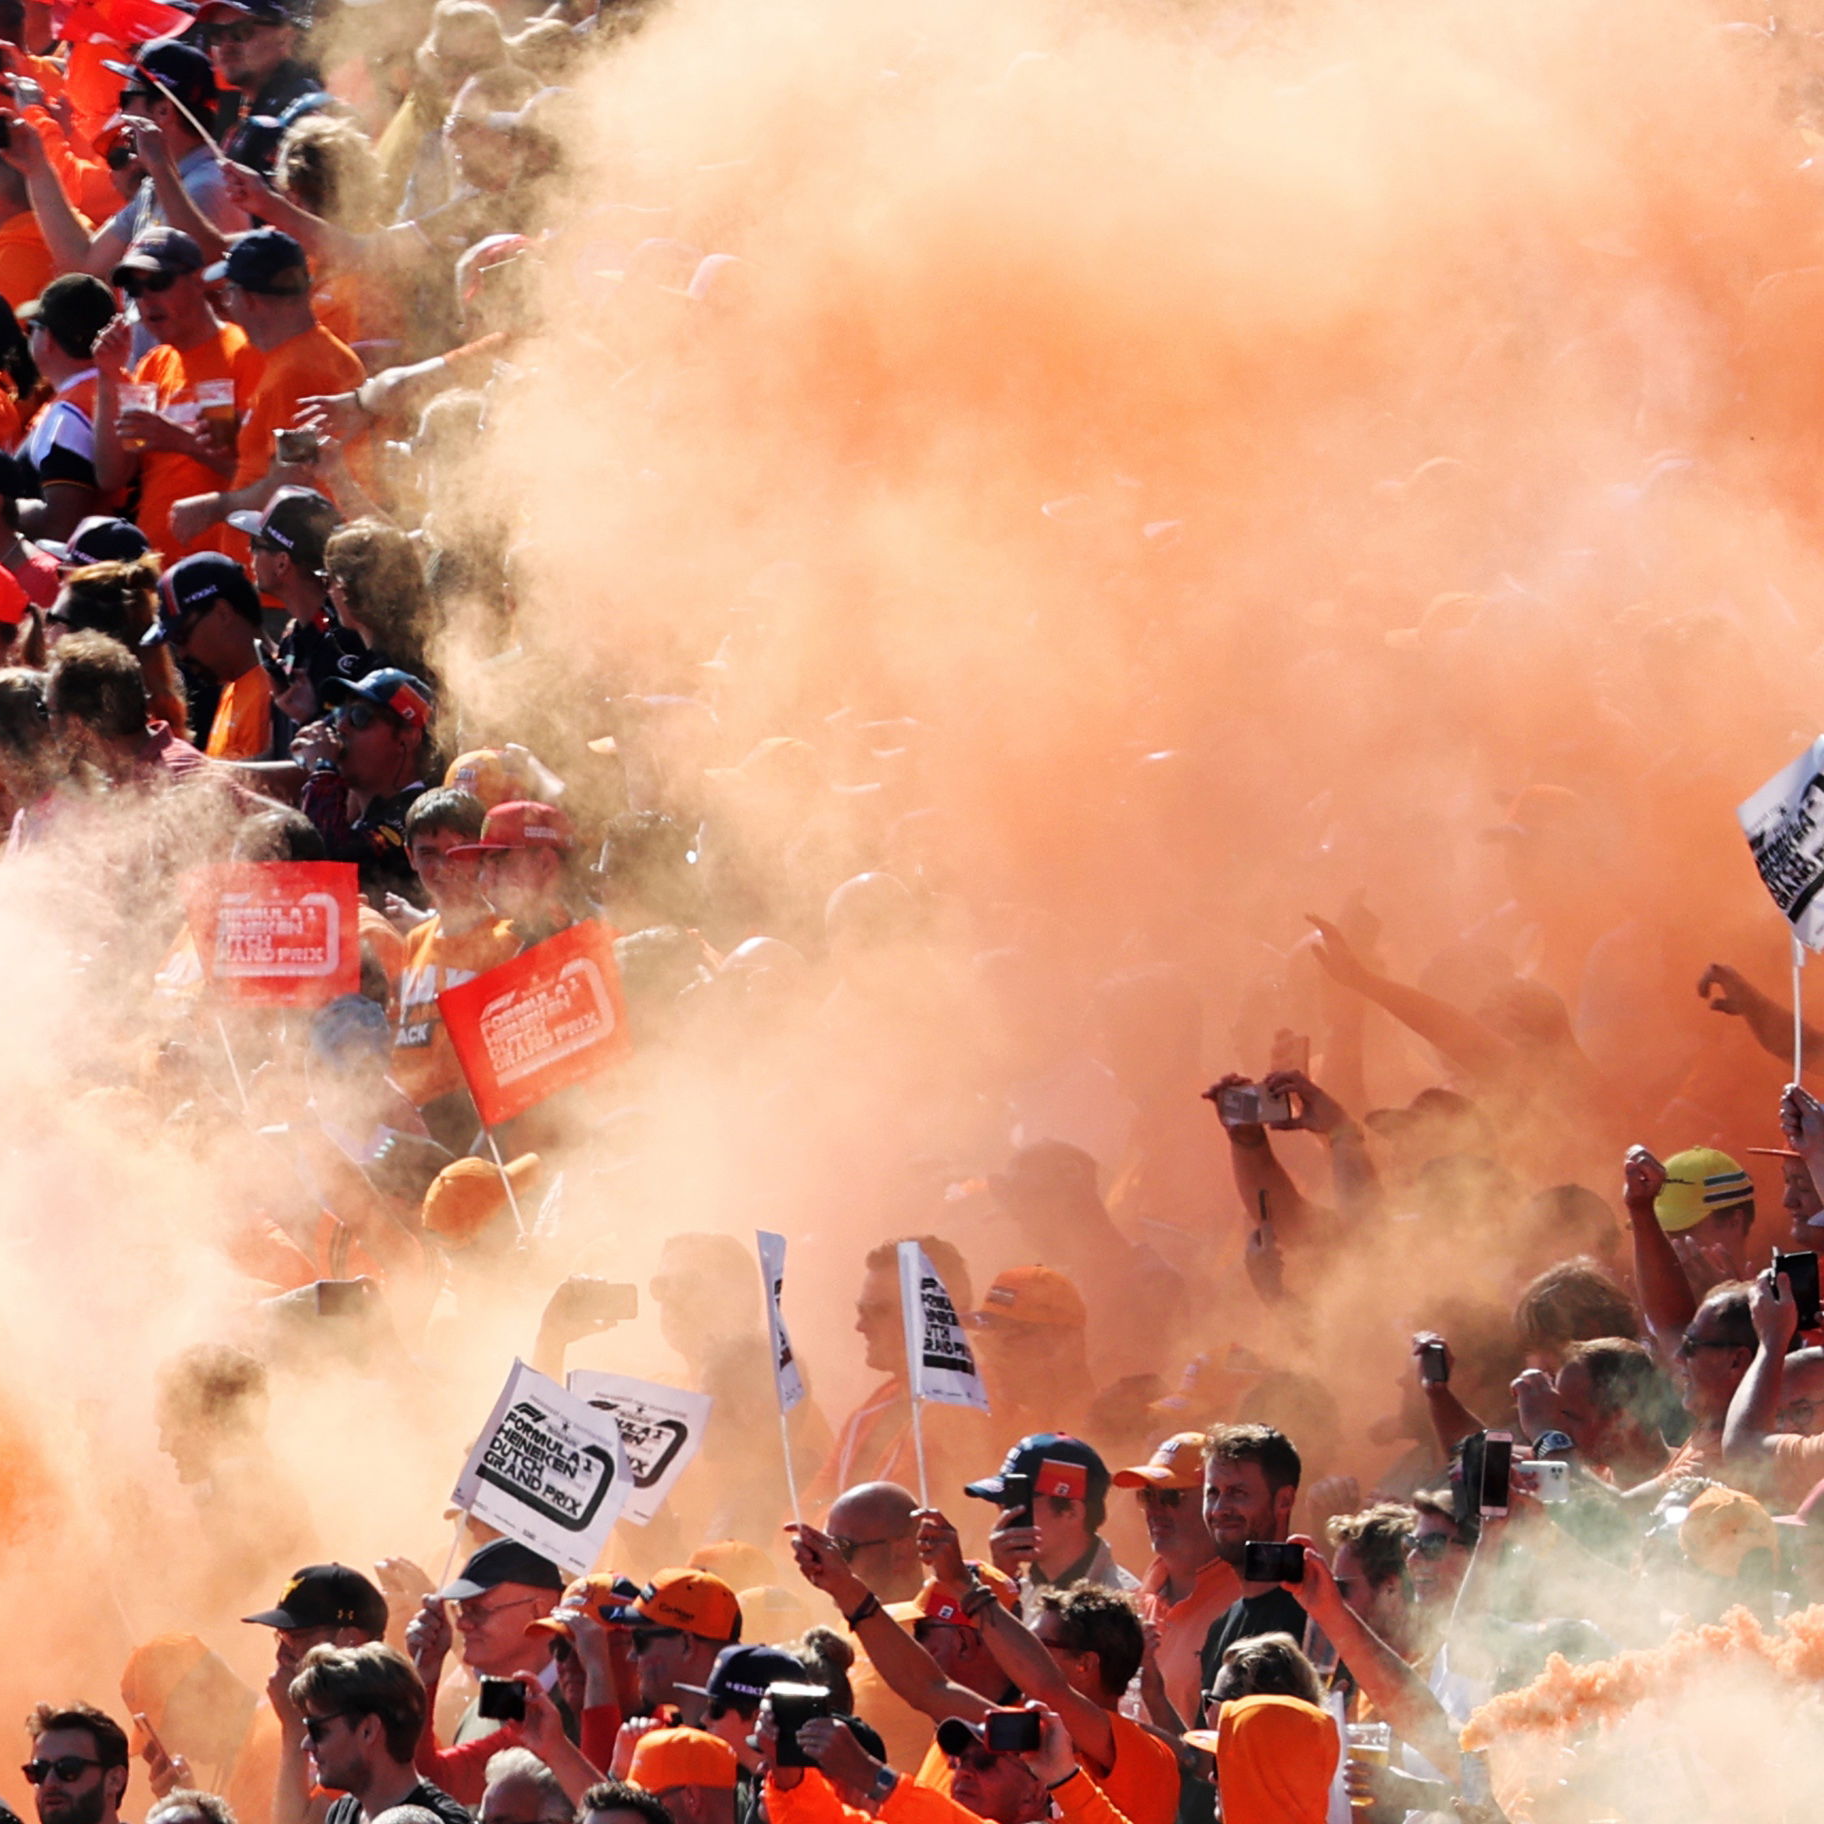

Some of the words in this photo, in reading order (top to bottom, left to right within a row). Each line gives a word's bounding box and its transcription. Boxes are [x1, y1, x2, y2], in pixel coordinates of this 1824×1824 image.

[396, 1023, 429, 1044] ACK
[489, 1438, 545, 1476] DUTCH
[497, 1423, 577, 1478] HEINEKEN
[505, 1411, 580, 1463] FORMULA
[584, 1460, 593, 1473] 1
[484, 1450, 542, 1491] GRAND
[541, 1485, 581, 1515] PRIX
